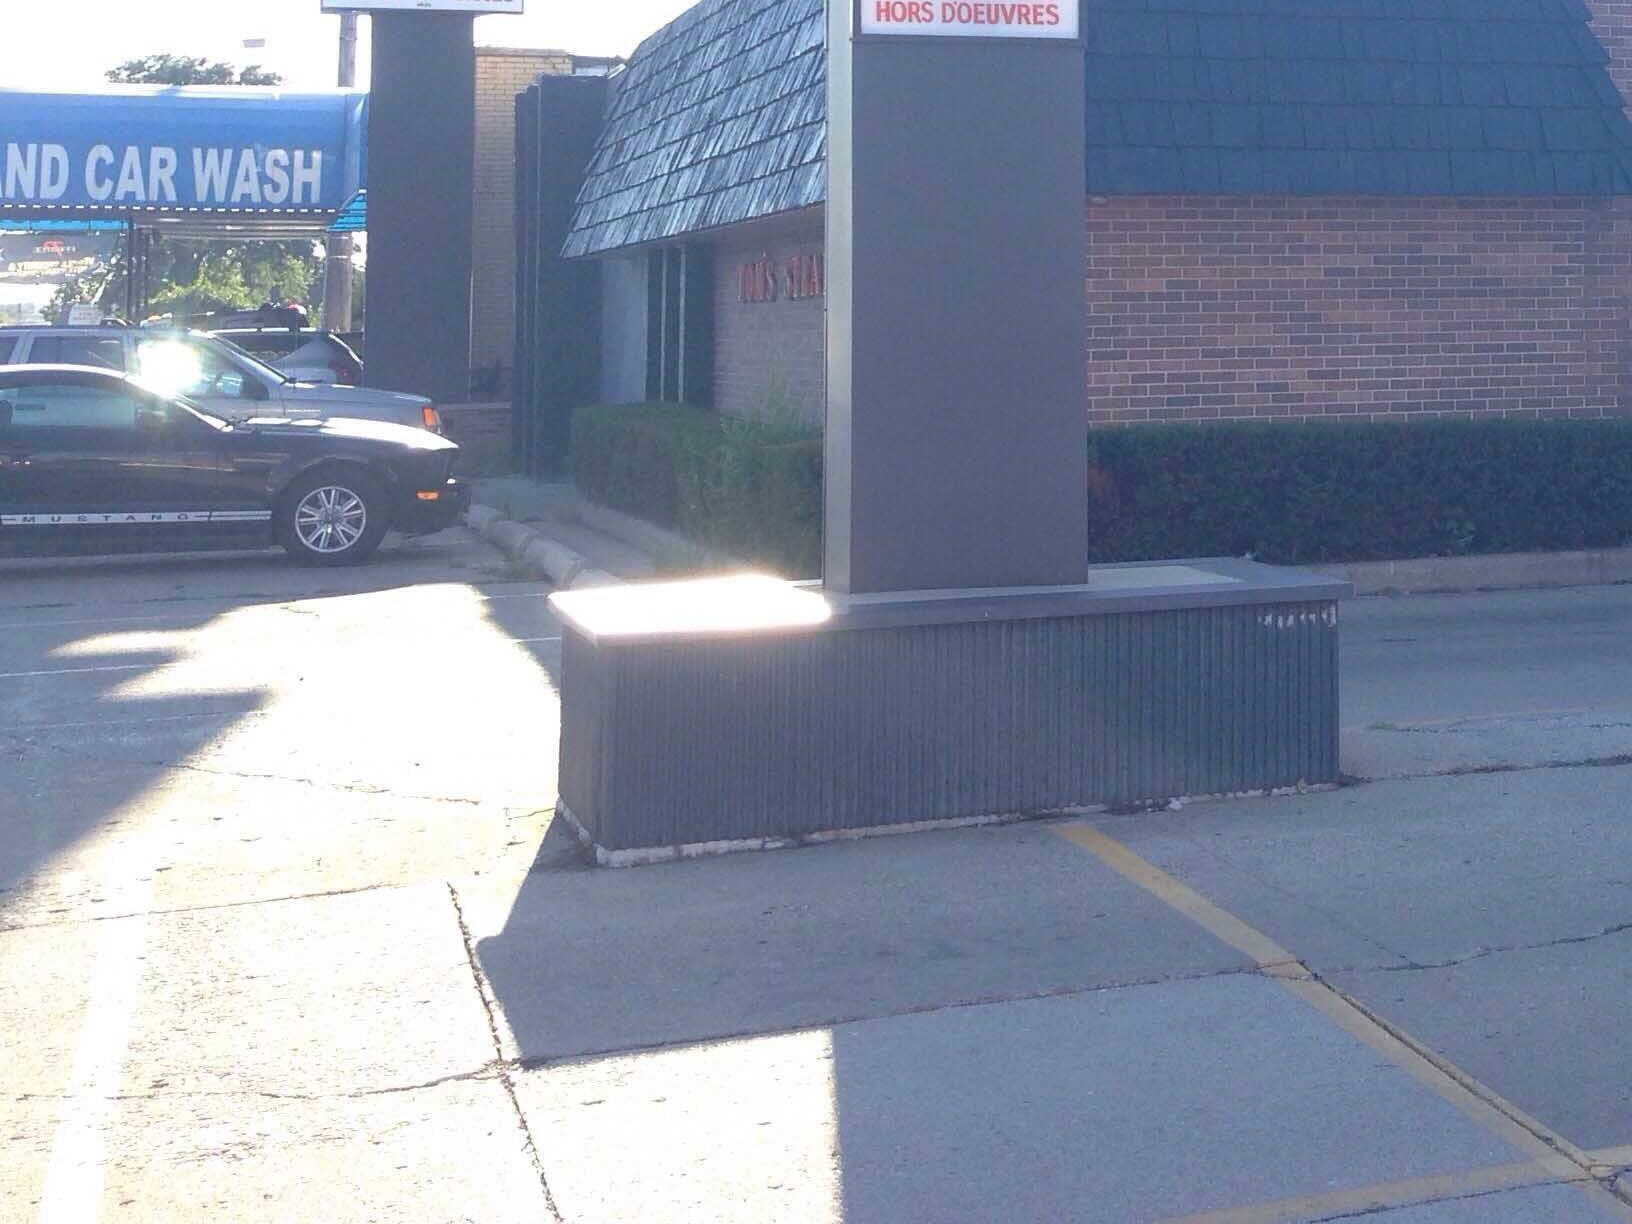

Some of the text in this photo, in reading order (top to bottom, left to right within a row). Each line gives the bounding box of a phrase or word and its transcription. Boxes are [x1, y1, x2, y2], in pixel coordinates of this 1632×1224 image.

[875, 0, 1060, 26] HORS D'OEUVRES
[0, 141, 323, 204] ND CAR WASH
[22, 512, 190, 523] MUSTANG
